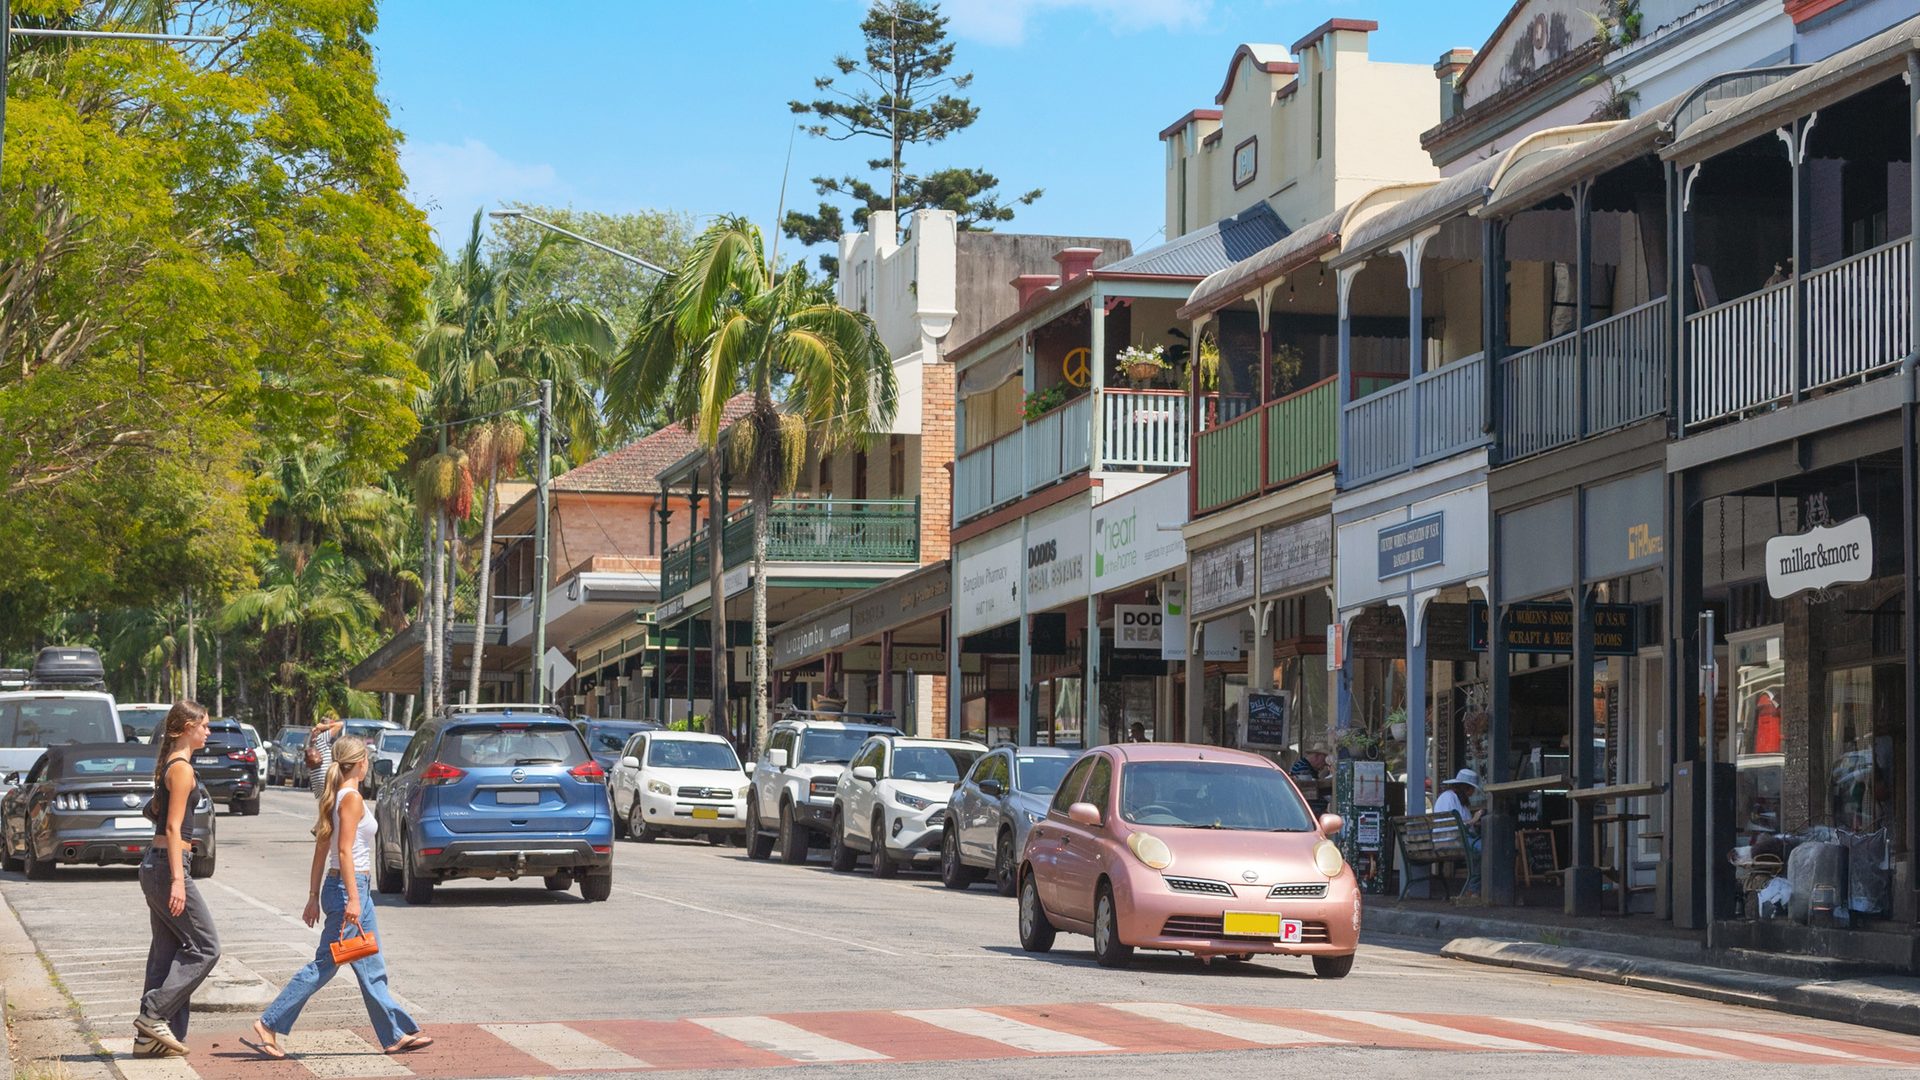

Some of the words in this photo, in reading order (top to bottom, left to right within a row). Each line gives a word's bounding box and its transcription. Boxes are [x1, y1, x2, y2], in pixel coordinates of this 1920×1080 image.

[1104, 505, 1137, 553] heart
[1028, 539, 1057, 569] DODDS
[1779, 541, 1860, 576] millar&more
[963, 571, 985, 596] Bangalow
[986, 566, 1008, 584] Pharmacy
[1028, 568, 1050, 595] REAL
[1052, 553, 1083, 586] ESTATE
[1123, 611, 1162, 626] DOD
[1516, 610, 1547, 625] WOMEN'S
[1595, 613, 1604, 625] OF
[1123, 626, 1162, 642] REA
[1594, 633, 1622, 647] ROOMS
[1284, 922, 1297, 939] P
